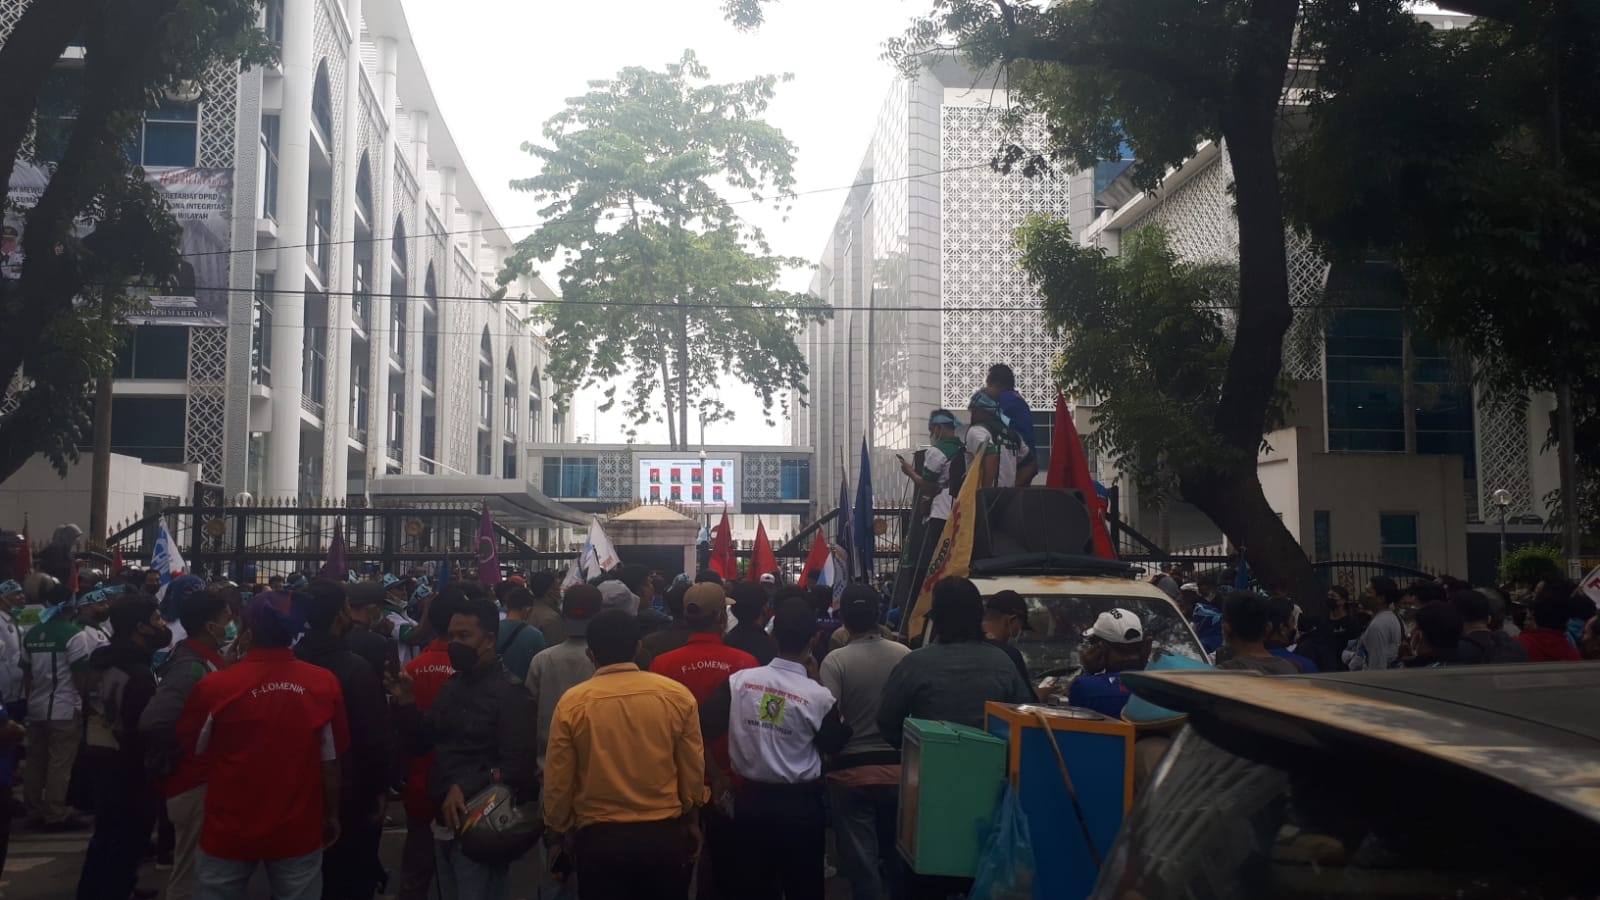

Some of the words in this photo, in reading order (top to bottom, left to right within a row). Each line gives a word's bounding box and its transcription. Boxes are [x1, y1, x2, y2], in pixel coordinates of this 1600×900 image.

[186, 203, 225, 211] INTEGRITAS
[177, 211, 209, 220] WILAYAH
[680, 660, 732, 673] F-LOMENIK
[250, 681, 306, 698] F-LOMENIK
